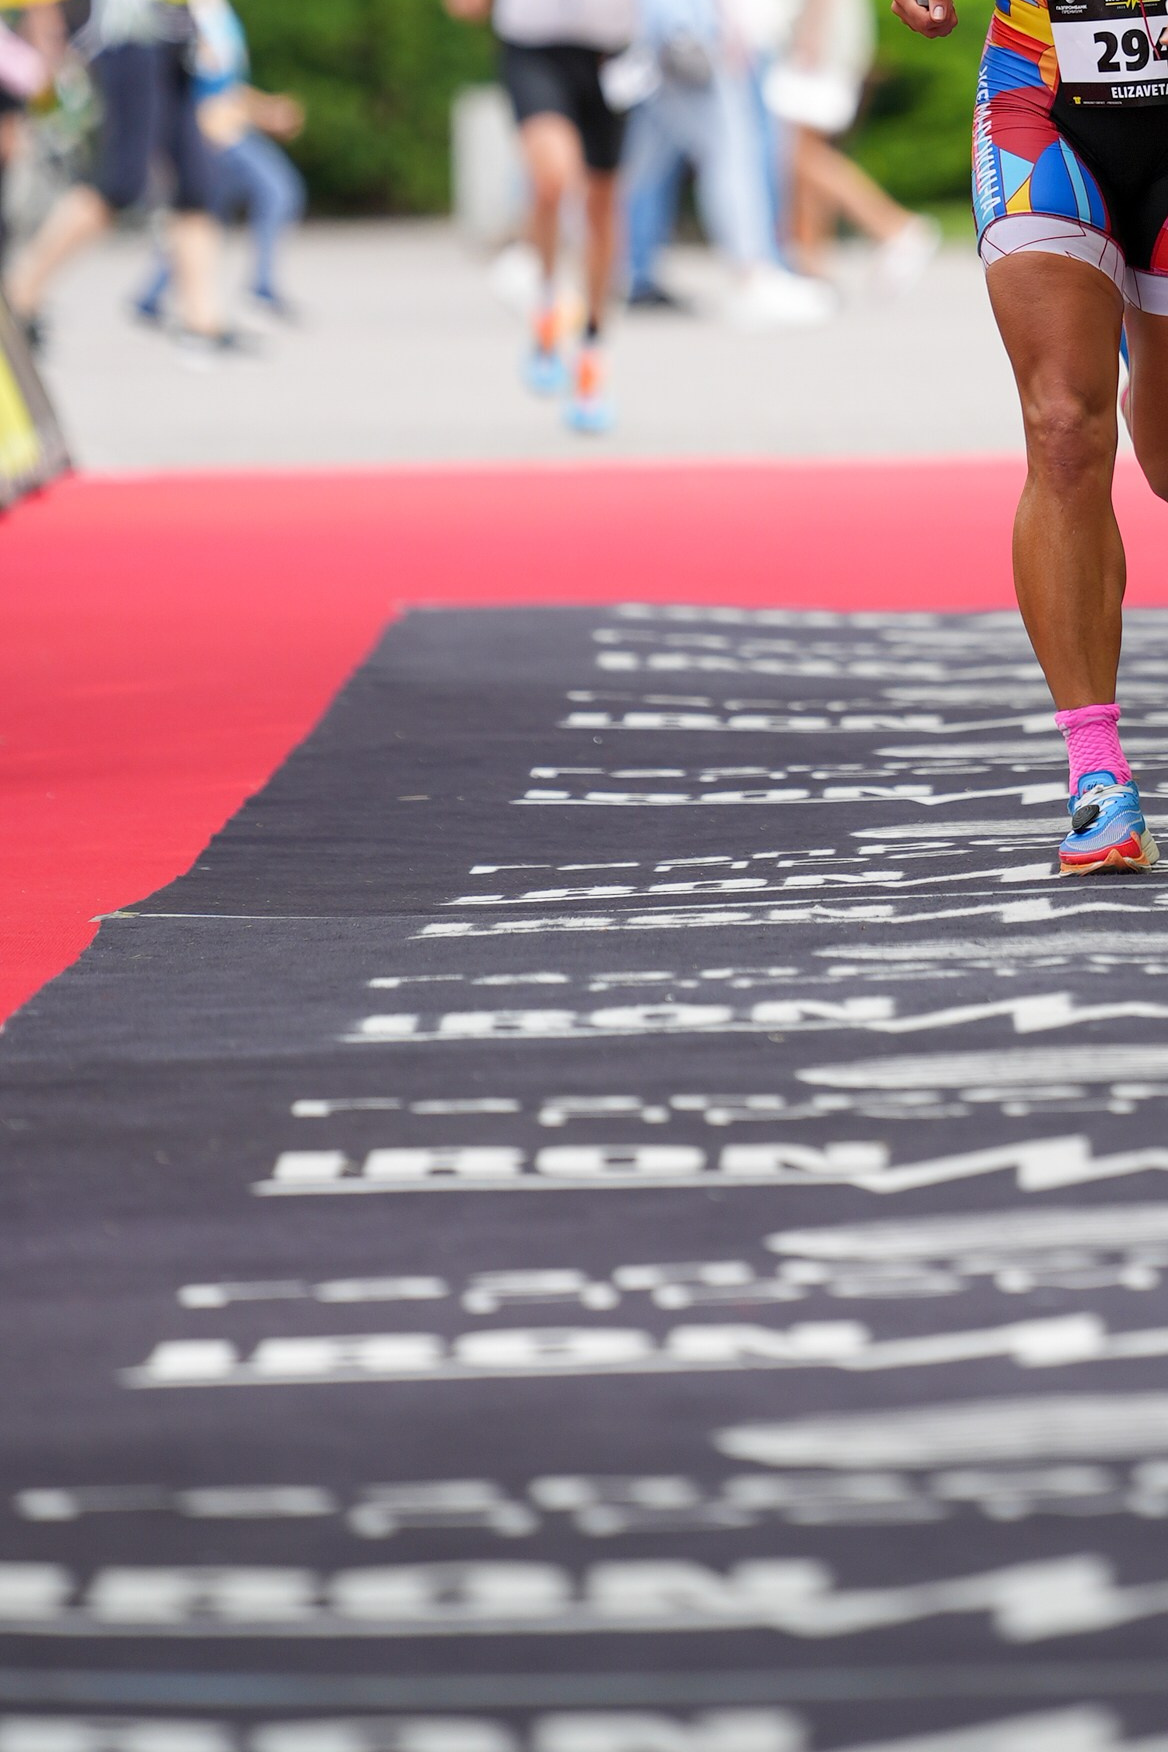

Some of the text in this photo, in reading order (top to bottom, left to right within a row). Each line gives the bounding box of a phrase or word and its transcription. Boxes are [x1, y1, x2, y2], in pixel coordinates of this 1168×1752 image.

[422, 904, 899, 935] IRON
[357, 995, 896, 1035] IRON
[270, 1138, 892, 1182] IRON
